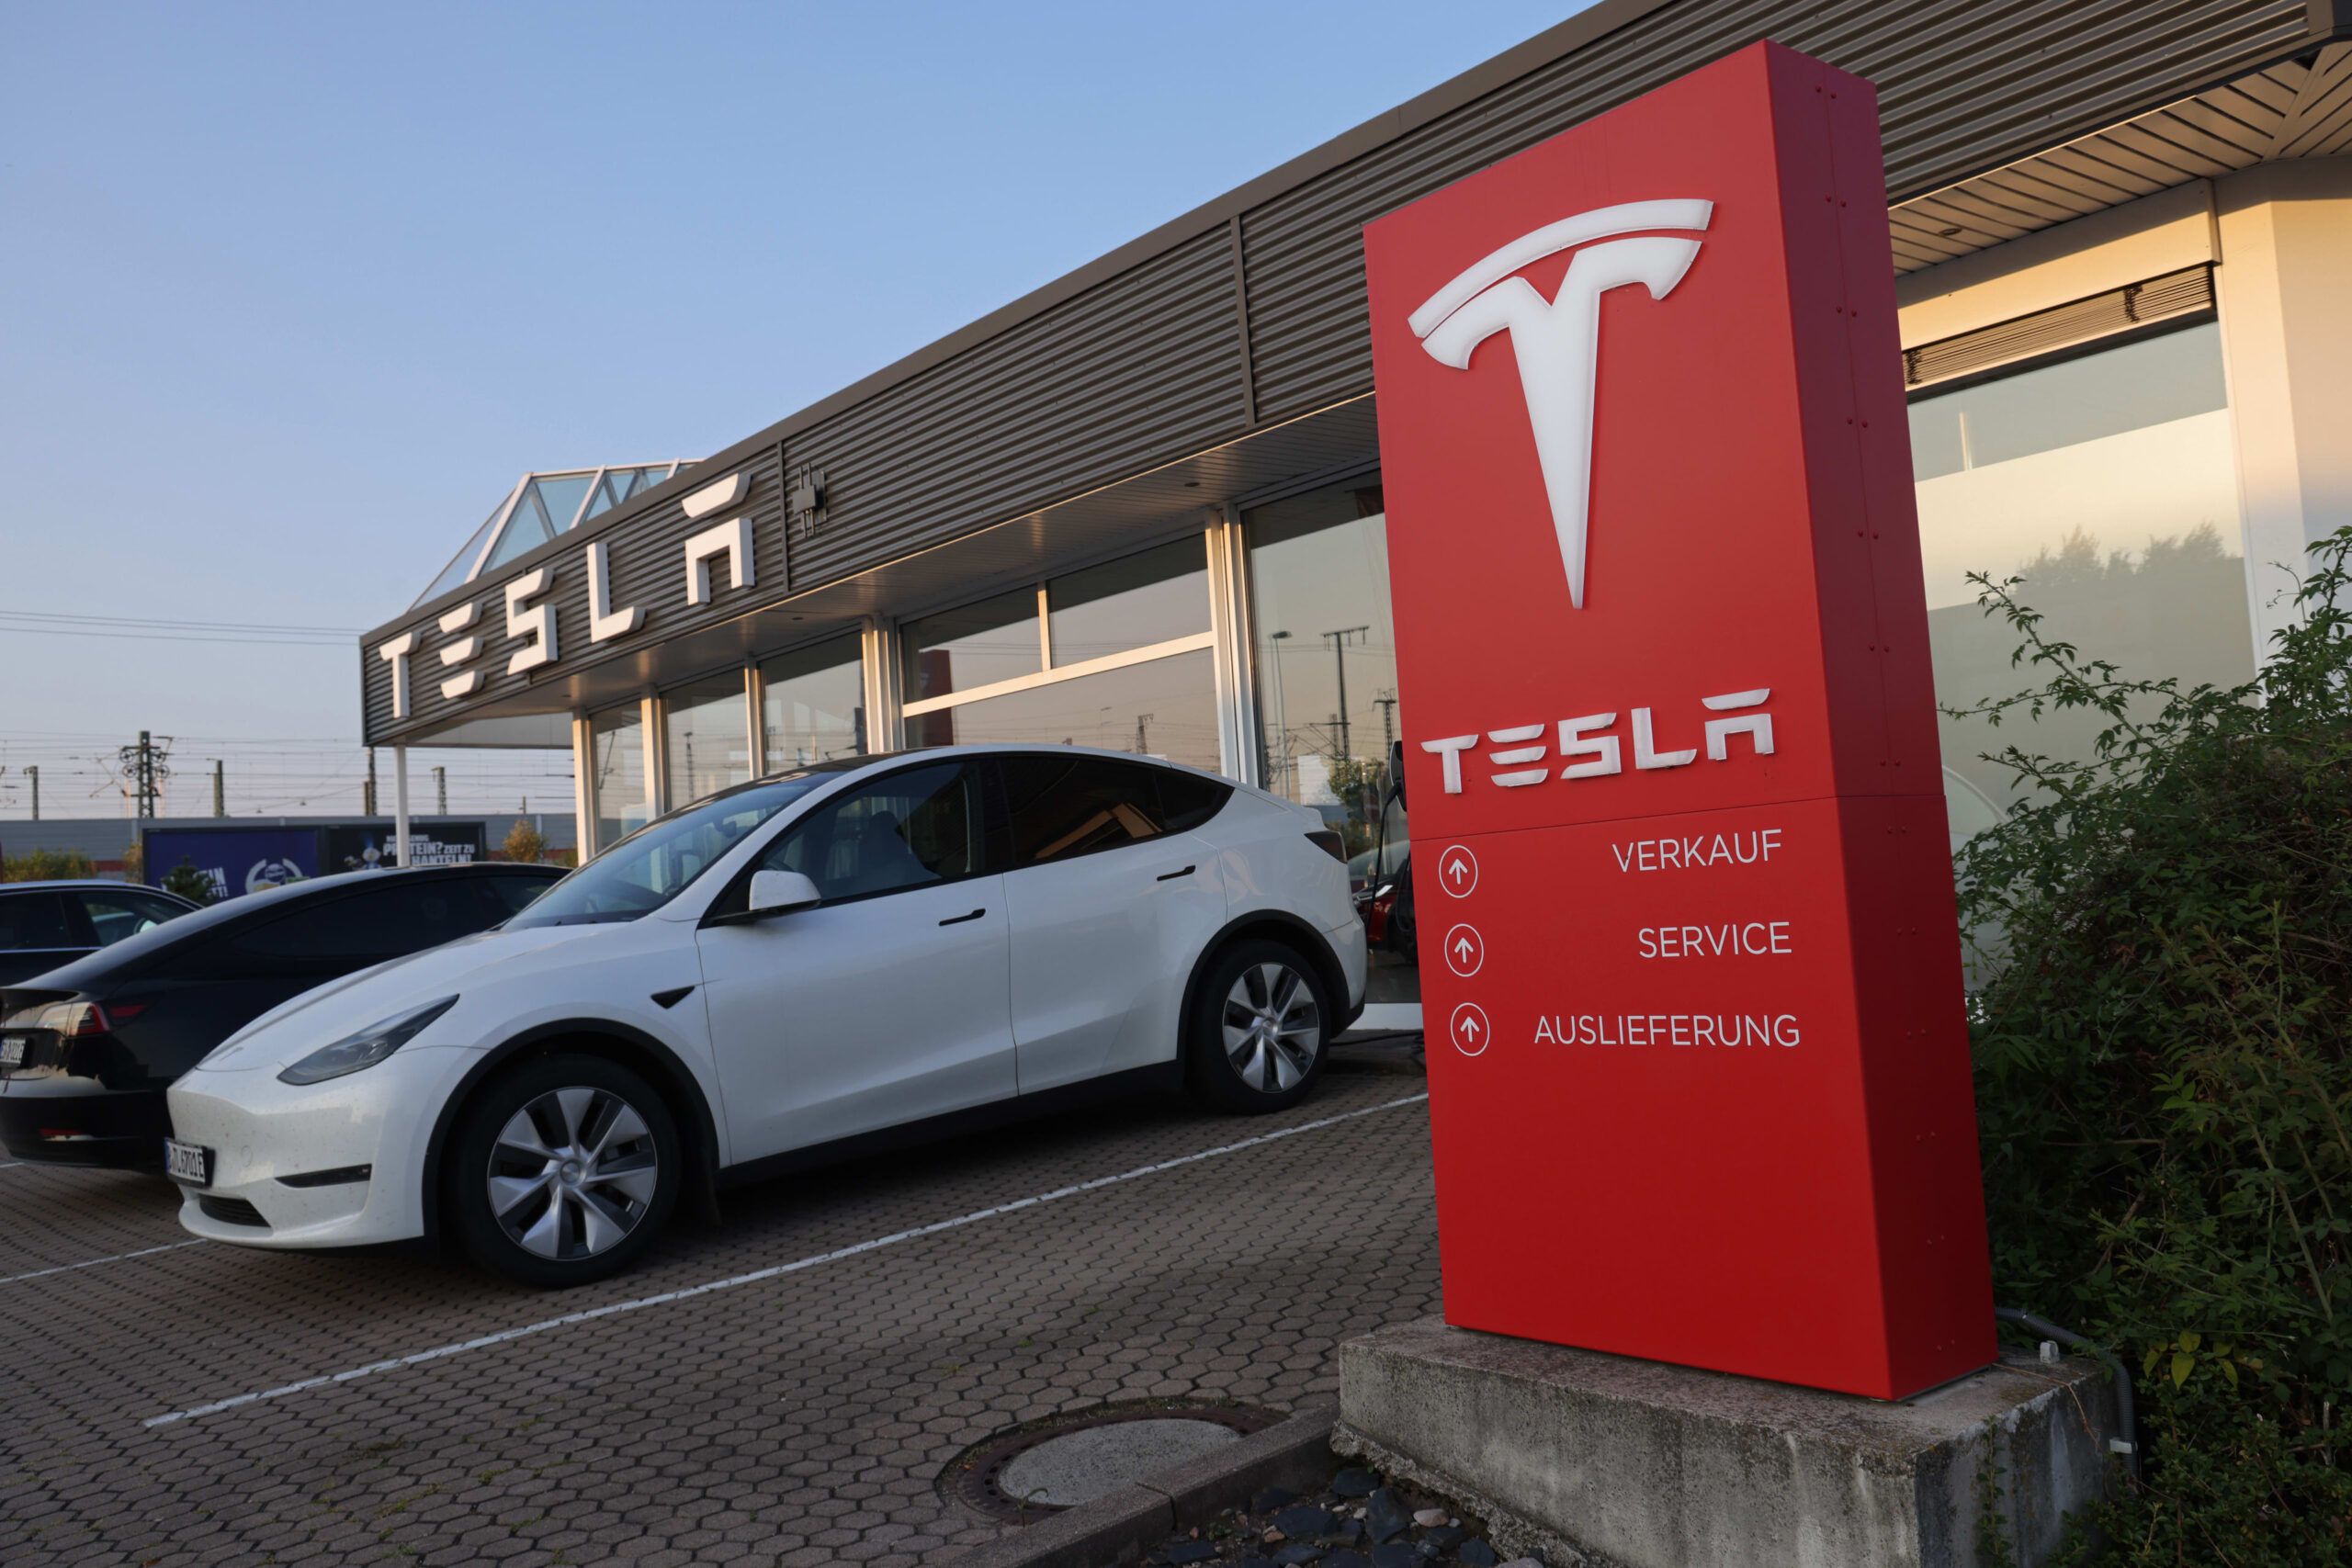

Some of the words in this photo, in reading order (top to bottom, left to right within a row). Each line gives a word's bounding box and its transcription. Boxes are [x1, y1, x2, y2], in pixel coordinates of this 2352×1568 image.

[379, 472, 755, 719] TESLA
[1420, 688, 1775, 795] TESLA
[382, 841, 443, 856] PRTEIN?
[1611, 829, 1782, 873] VERKAUF
[1638, 921, 1792, 959] SERVICE
[1533, 1014, 1801, 1048] AUSLIEFERUNG
